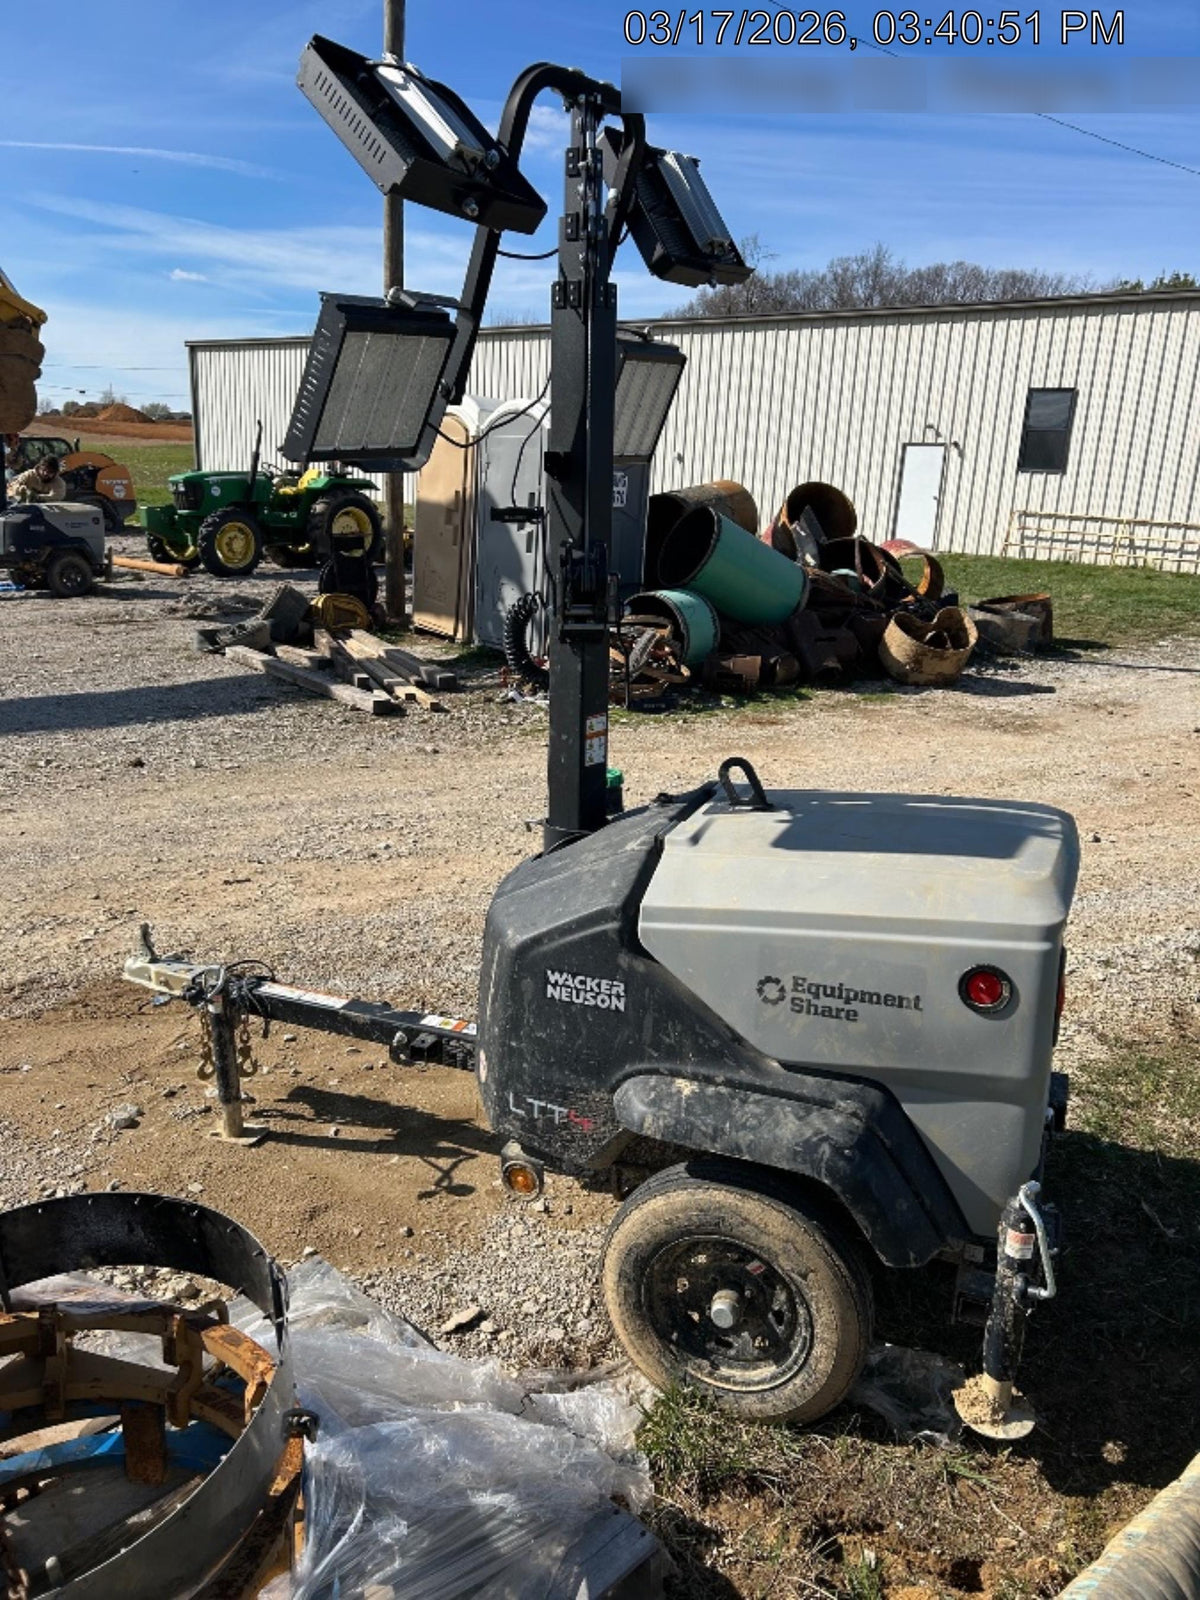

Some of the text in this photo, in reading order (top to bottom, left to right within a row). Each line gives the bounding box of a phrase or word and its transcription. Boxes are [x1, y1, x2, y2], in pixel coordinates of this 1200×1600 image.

[546, 969, 625, 996] WACKER
[791, 976, 923, 1011] Equipment
[546, 984, 626, 1012] NEUSON
[790, 996, 859, 1022] Share
